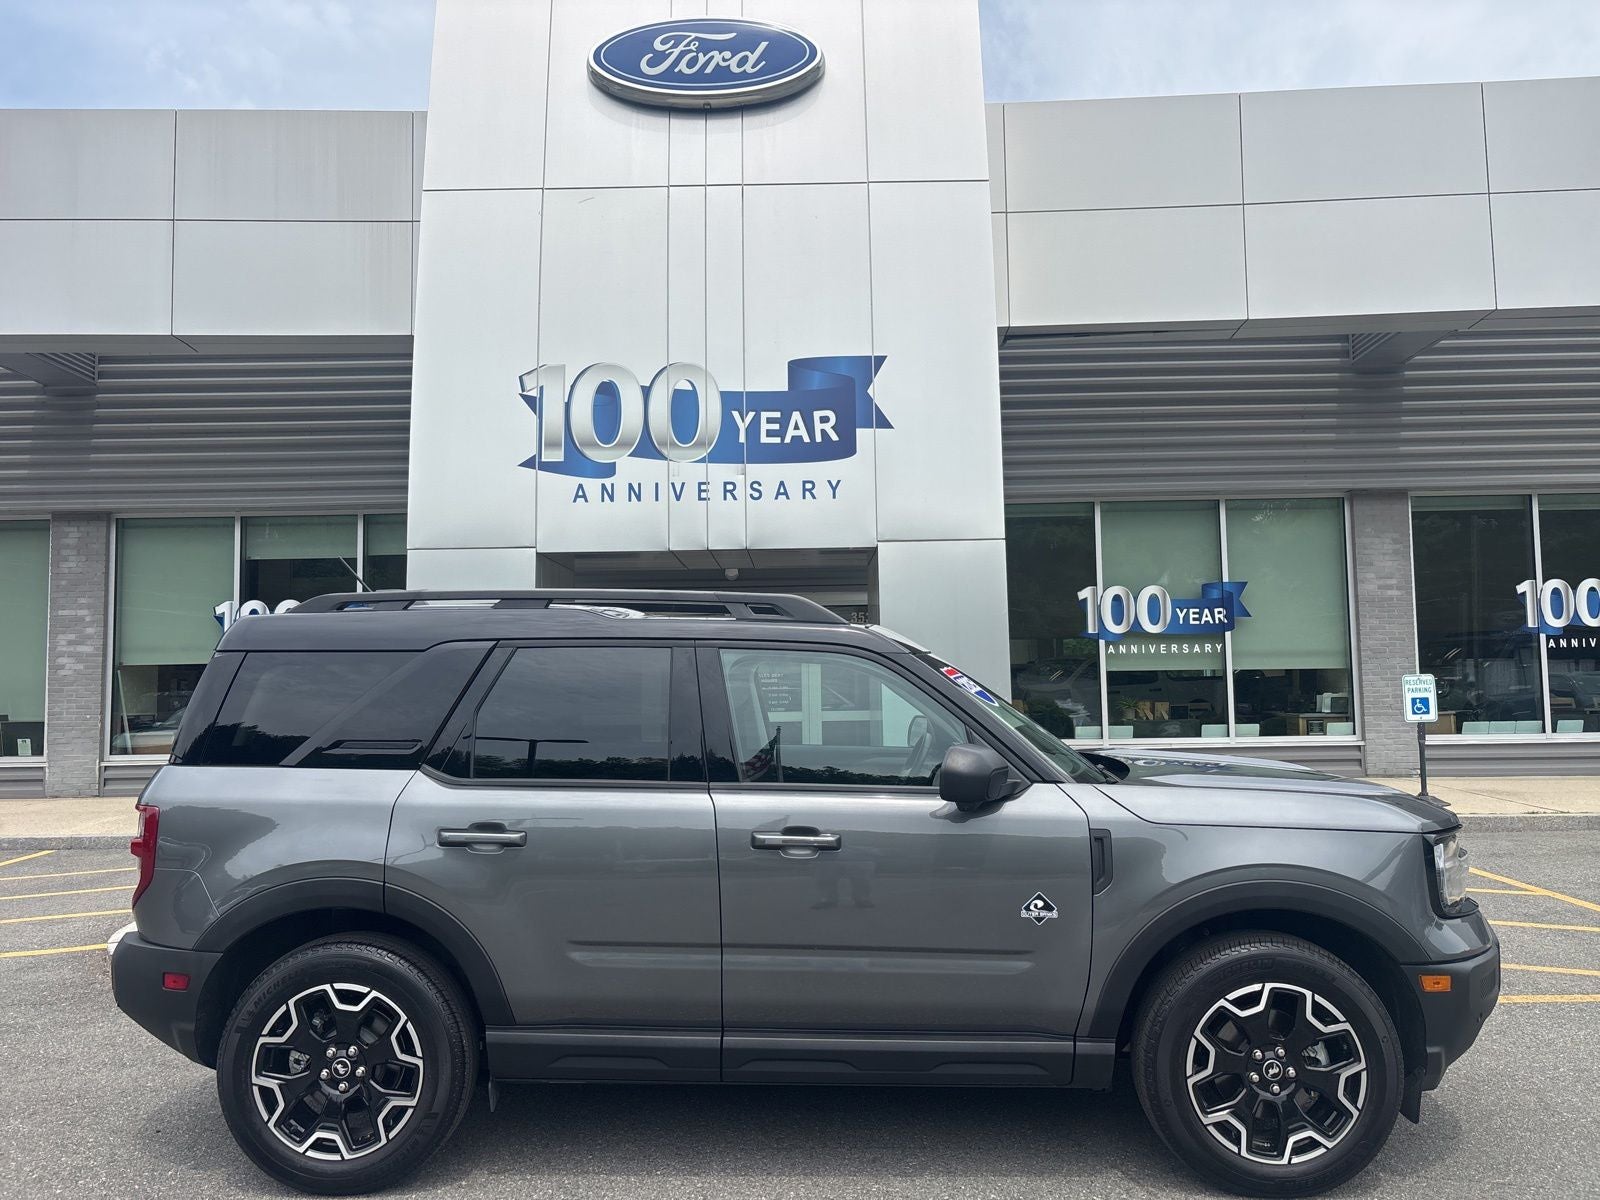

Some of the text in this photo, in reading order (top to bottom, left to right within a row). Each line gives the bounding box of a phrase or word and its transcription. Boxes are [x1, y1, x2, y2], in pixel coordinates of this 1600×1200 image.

[640, 32, 769, 76] Ford
[518, 361, 839, 463] 100 YEAR
[572, 479, 842, 503] ANNIVERSARY
[1077, 585, 1228, 634] 100 YEAR
[1516, 578, 1600, 627] 100
[1107, 643, 1223, 654] ANNIVERSARY
[1547, 637, 1597, 649] ANNIV
